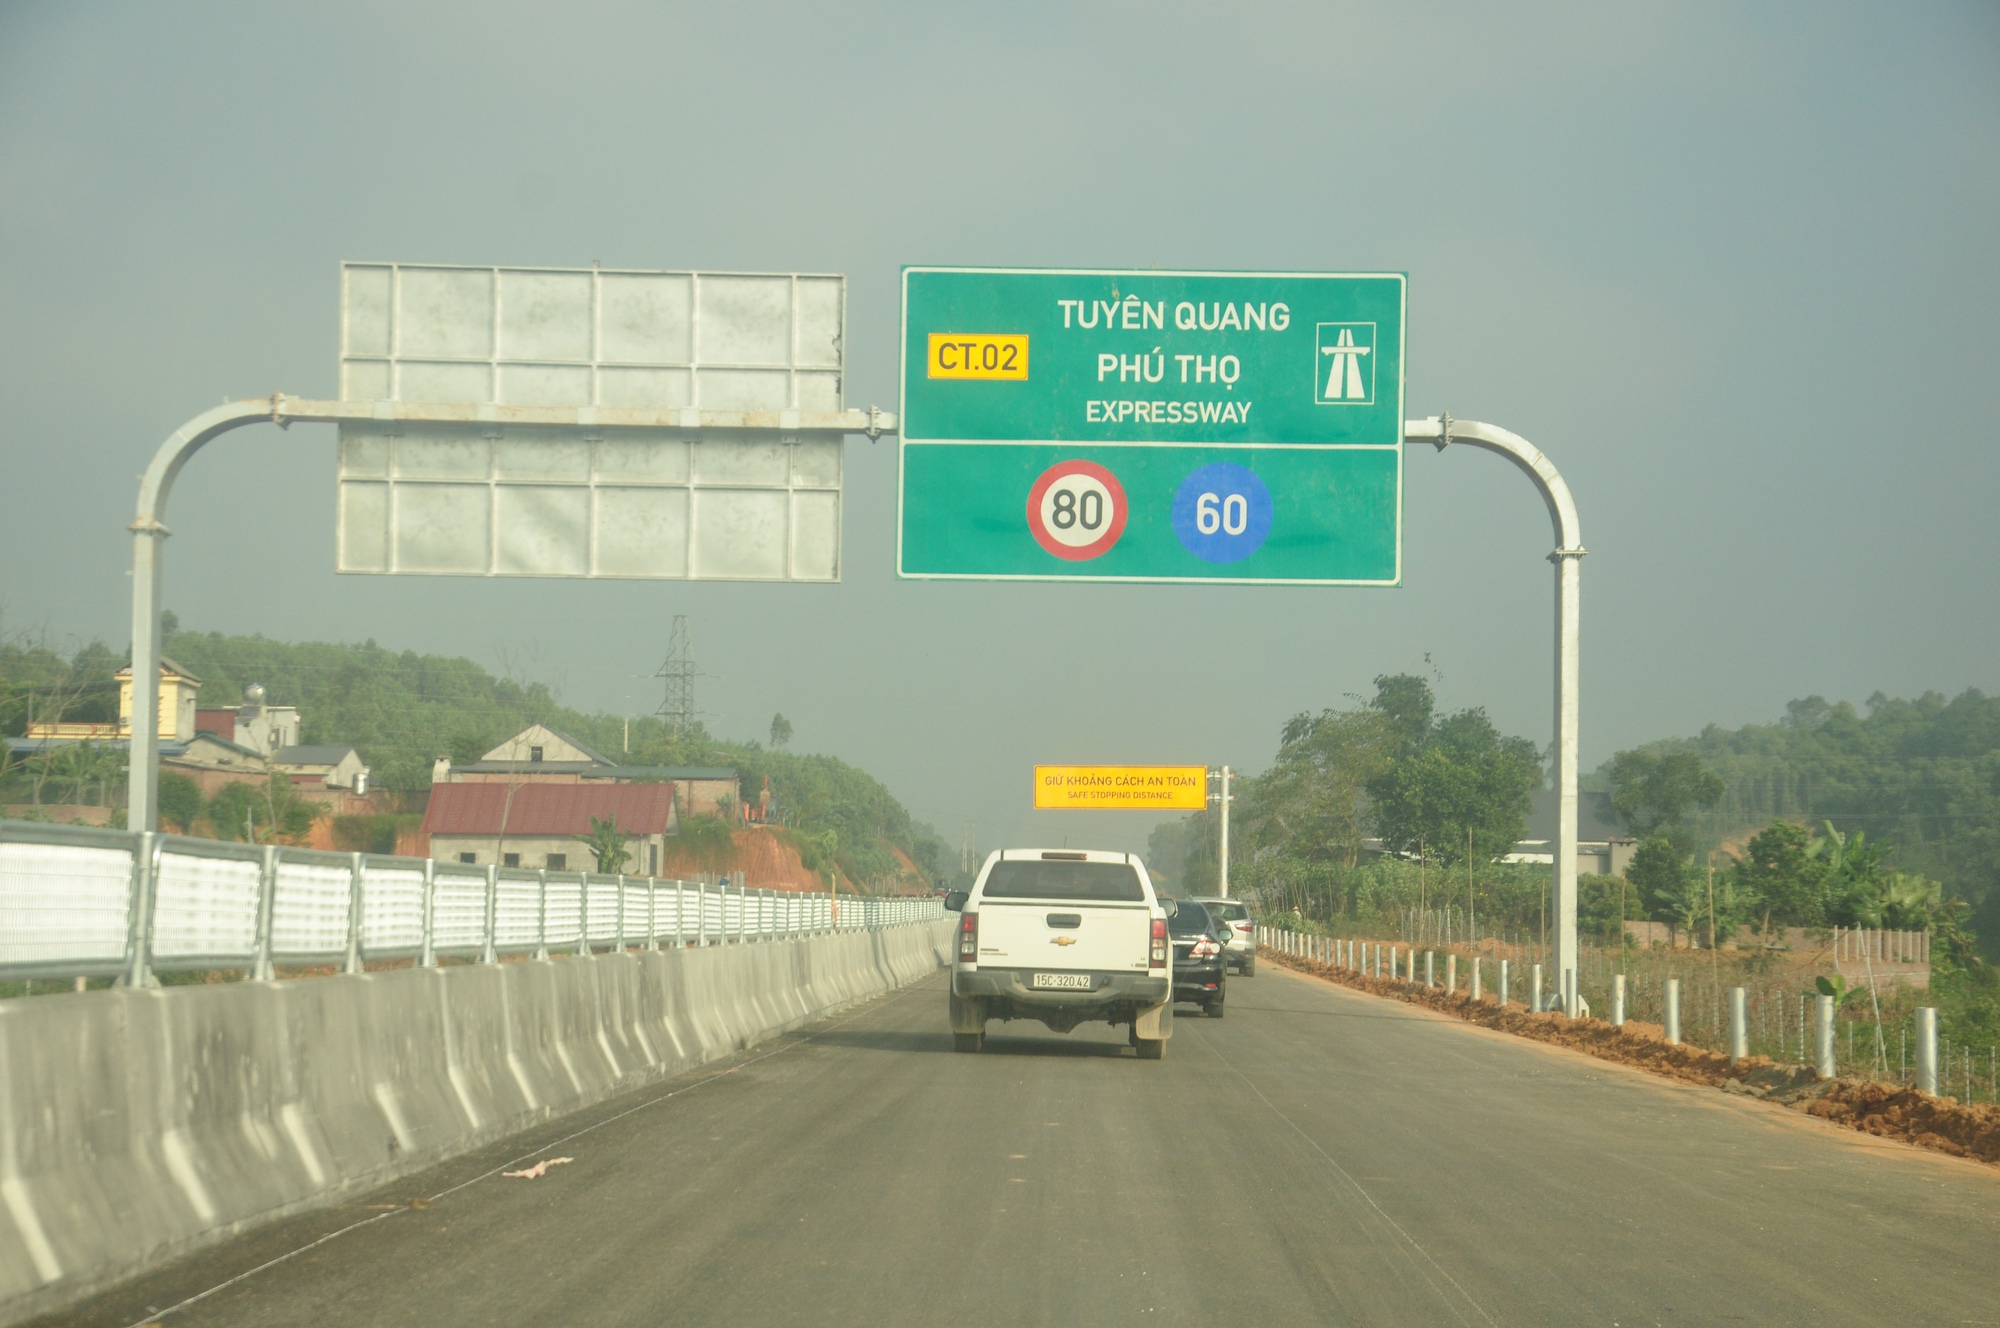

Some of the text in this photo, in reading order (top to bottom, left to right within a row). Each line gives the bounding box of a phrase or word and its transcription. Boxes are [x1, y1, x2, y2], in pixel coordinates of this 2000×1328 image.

[1057, 294, 1290, 331] TUYÊN QUANG
[938, 342, 1018, 372] CT.02
[1098, 346, 1241, 390] PHÚ THỌ
[1086, 400, 1252, 423] EXPRESSWAY
[1052, 489, 1103, 530] 80
[1196, 493, 1248, 536] 60
[1066, 773, 1112, 786] KHOẢNG
[1115, 774, 1144, 786] CÁCH
[1147, 776, 1163, 786] AN
[1166, 774, 1196, 786] TOÀN
[1068, 791, 1173, 800] SAFE STOPPING DISTANCE
